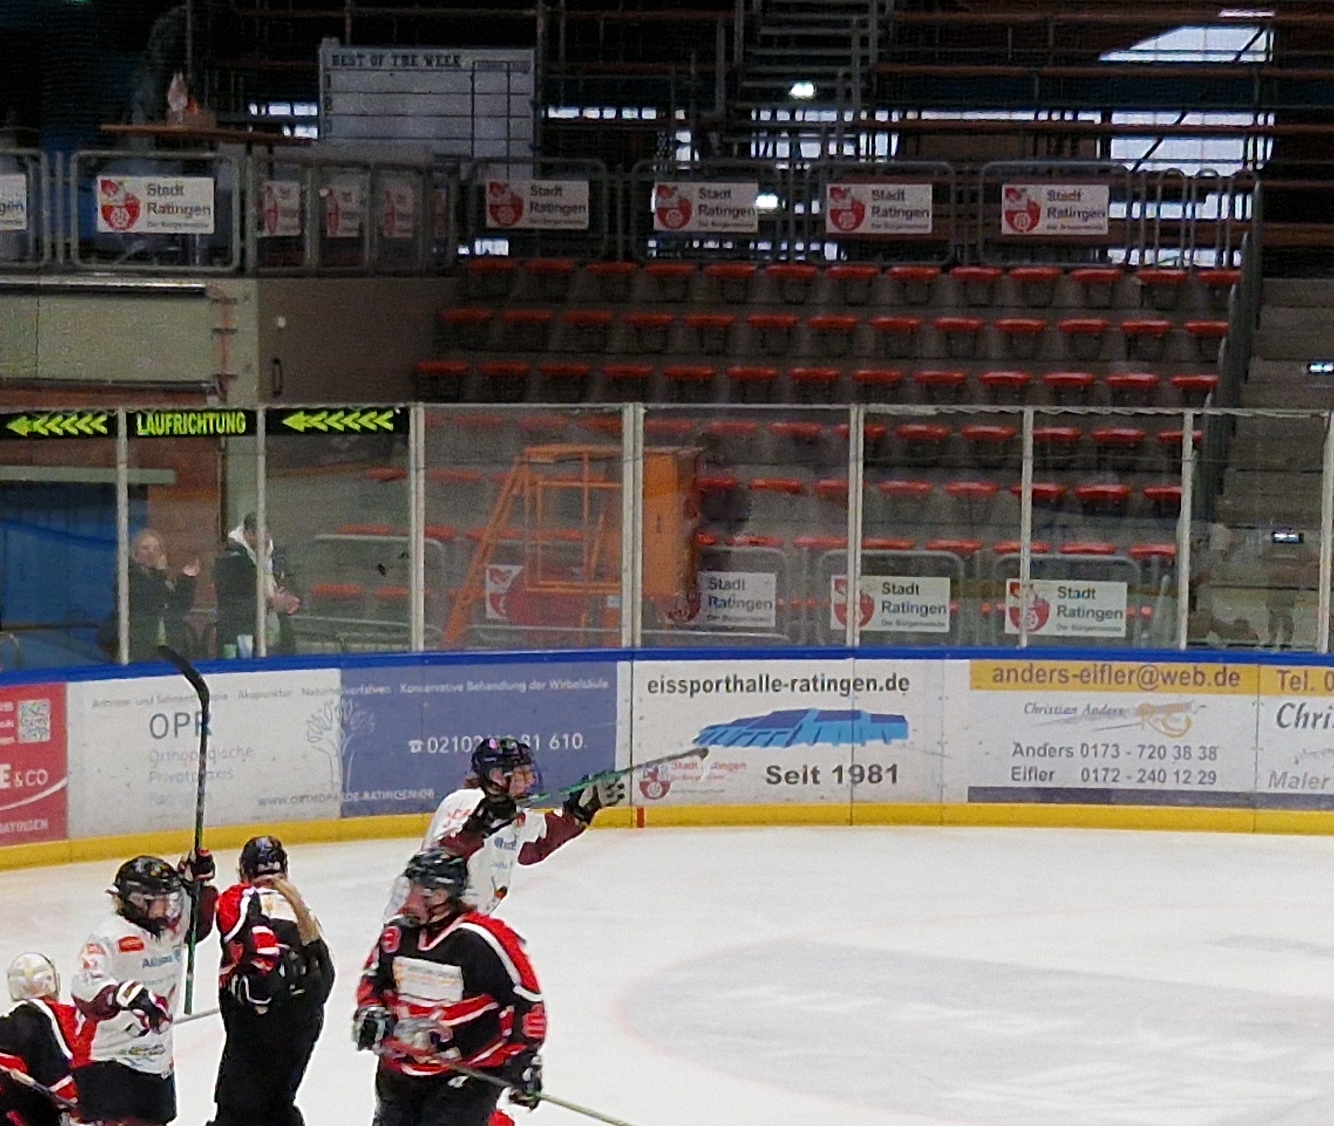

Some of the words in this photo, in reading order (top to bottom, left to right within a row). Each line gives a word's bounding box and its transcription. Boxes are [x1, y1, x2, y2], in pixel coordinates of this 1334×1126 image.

[146, 184, 184, 197] Stadt
[699, 187, 732, 199] Stadt
[871, 189, 905, 201] Stadt
[147, 203, 211, 217] Ratingen
[530, 202, 587, 214] Ratingen
[699, 204, 756, 218] Ratingen
[871, 206, 930, 219] Ratingen
[136, 411, 247, 436] LAUFRICHTUNG
[708, 577, 746, 590] Stadt
[881, 581, 920, 595] Stadt
[1057, 586, 1096, 599] Stadt
[708, 596, 773, 611] Ratingen
[881, 600, 947, 617] Ratingen
[1056, 604, 1123, 620] Ratingen
[647, 672, 911, 698] eissporthalle-ratingen.de
[992, 664, 1241, 691] anders-eifler@web.de
[1276, 670, 1314, 693] Tel.
[1012, 742, 1074, 758] Anders
[1080, 743, 1120, 759] 0173
[1137, 744, 1167, 760] 720
[1198, 745, 1218, 761] 38
[766, 764, 821, 786] Seit
[832, 763, 900, 785] 1981
[1011, 766, 1055, 782] Eifler
[1081, 767, 1121, 783] 0172
[1137, 768, 1167, 783] 240
[1173, 769, 1192, 784] 12
[1198, 769, 1218, 785] 29
[1267, 769, 1332, 791] Maler
